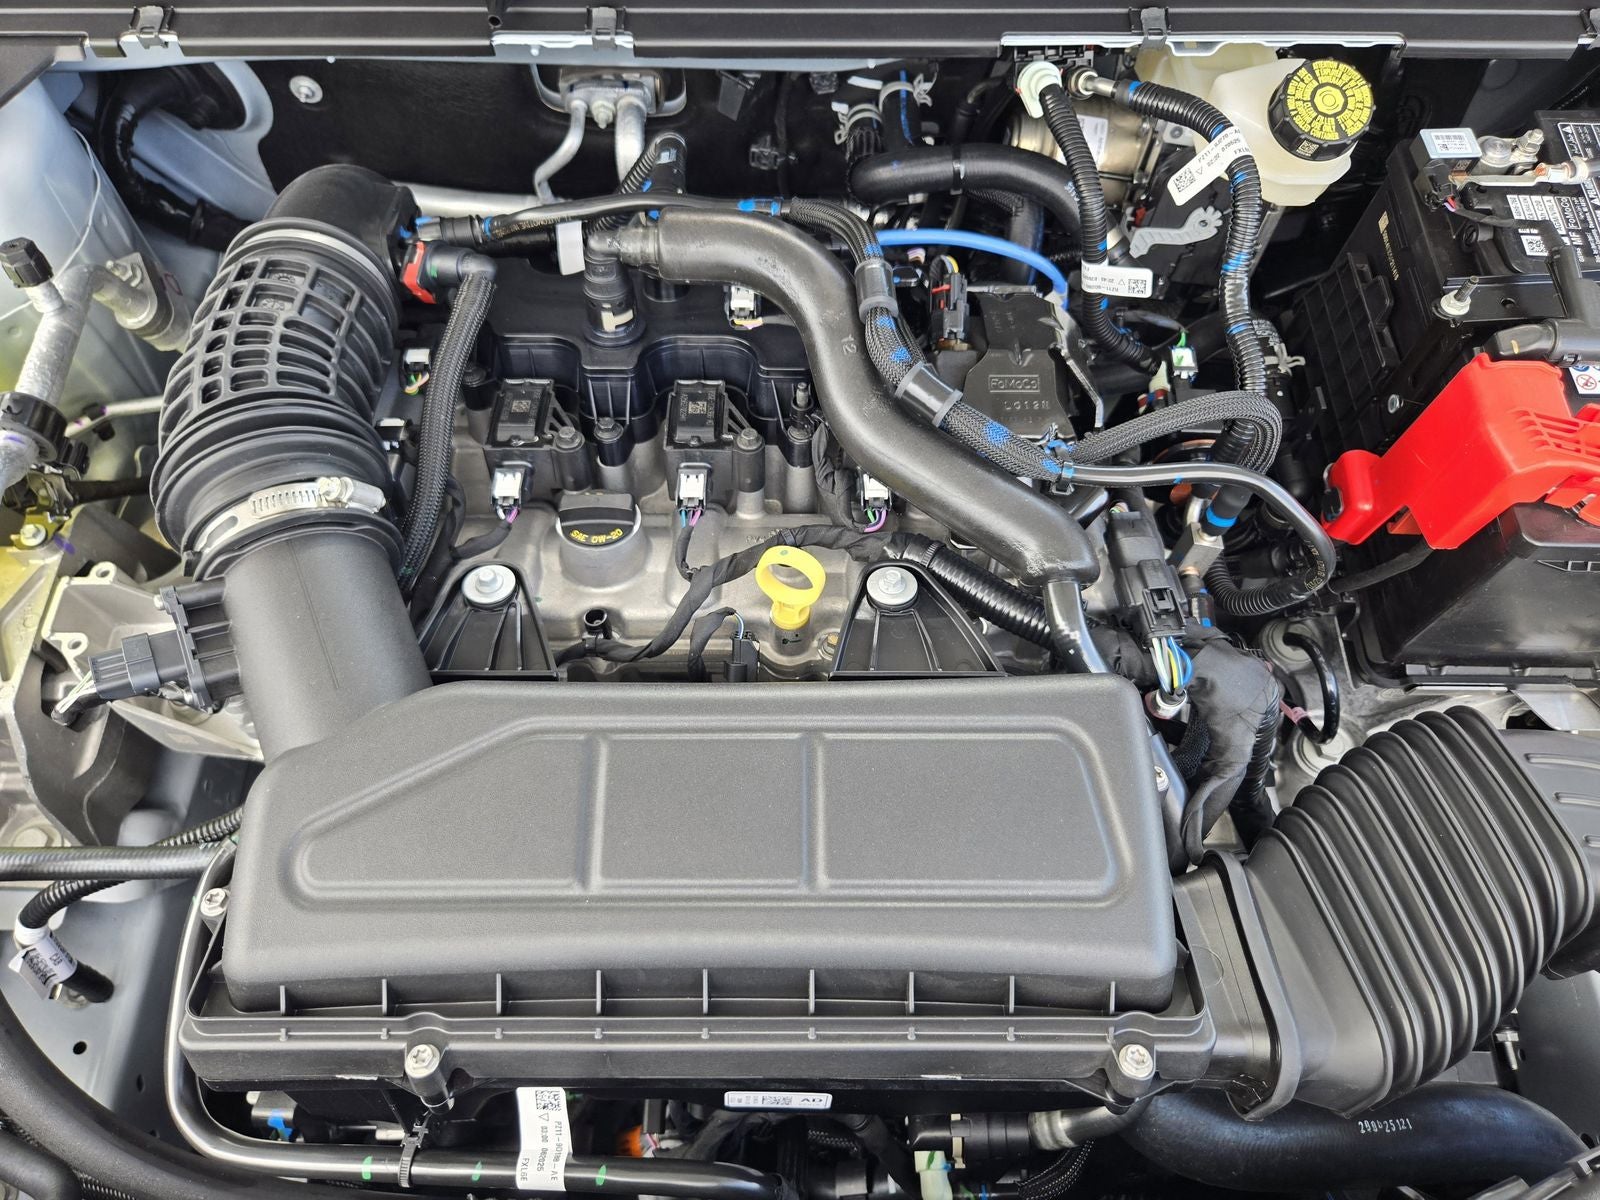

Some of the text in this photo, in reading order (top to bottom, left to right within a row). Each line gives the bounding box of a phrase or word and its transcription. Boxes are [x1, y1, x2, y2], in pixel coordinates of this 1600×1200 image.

[1561, 197, 1577, 229] FoMoCo
[990, 379, 1038, 389] FoMoCo
[570, 529, 589, 543] SAE
